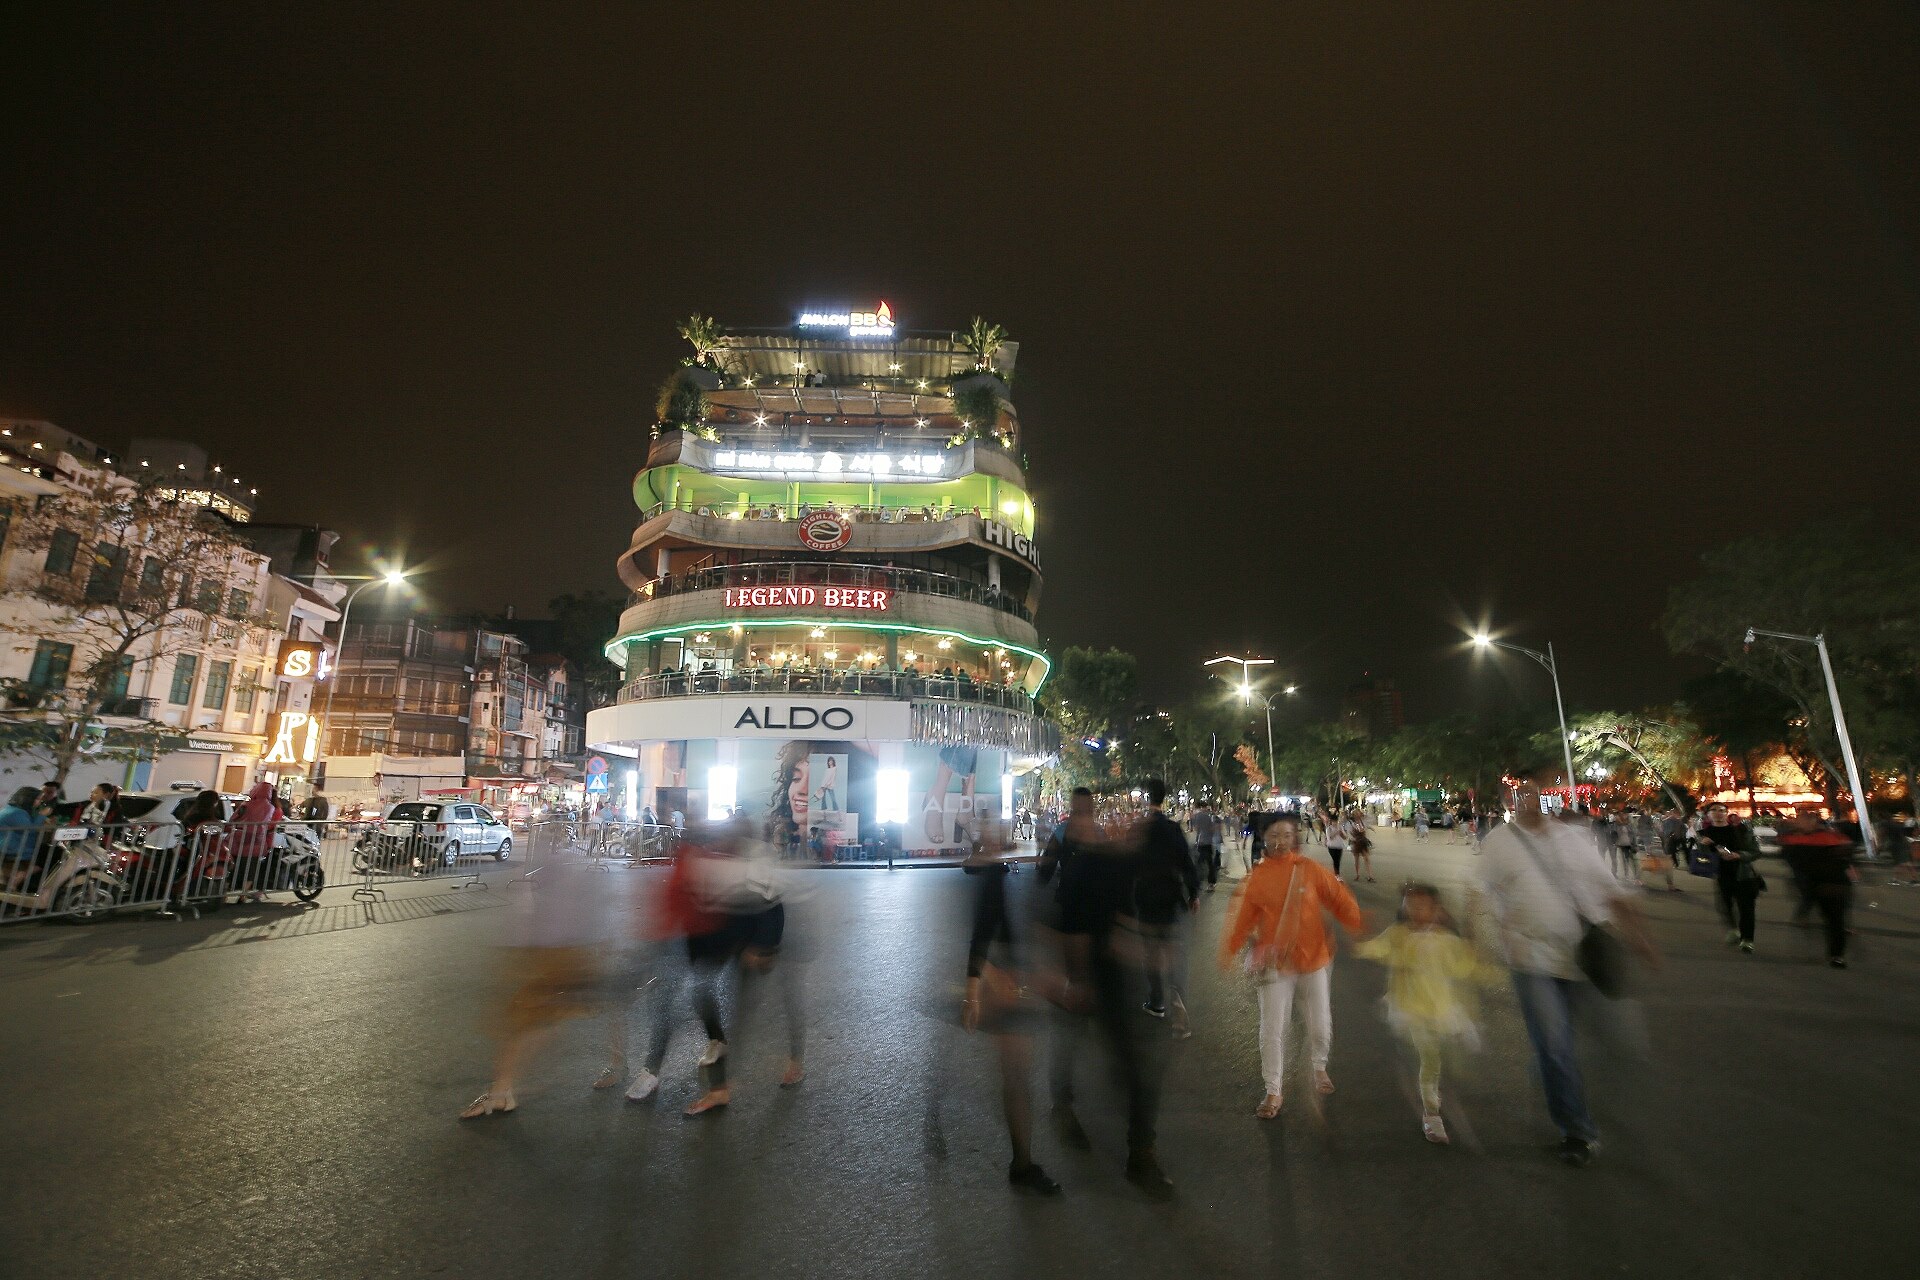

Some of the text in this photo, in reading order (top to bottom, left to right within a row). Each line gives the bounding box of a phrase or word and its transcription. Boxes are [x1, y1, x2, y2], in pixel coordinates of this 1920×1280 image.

[801, 513, 849, 530] HIGHLANDS
[806, 540, 843, 549] COFFEE
[726, 588, 887, 610] LEGEND BEER
[733, 706, 854, 730] ALDO
